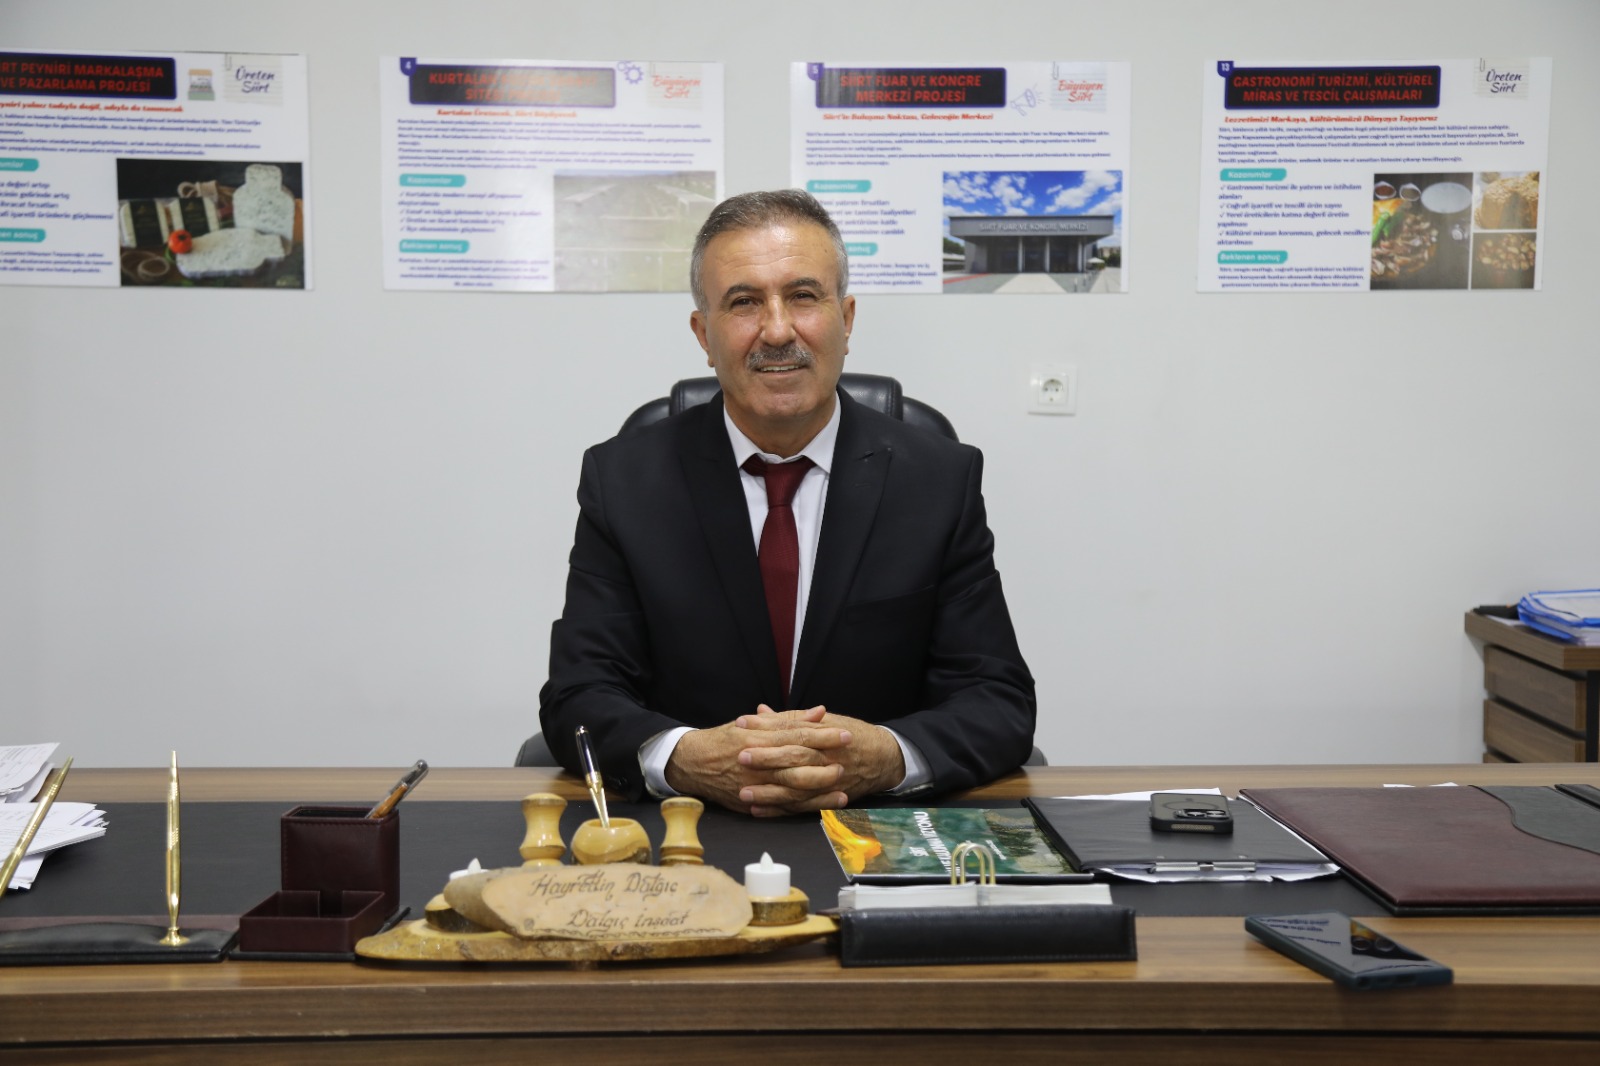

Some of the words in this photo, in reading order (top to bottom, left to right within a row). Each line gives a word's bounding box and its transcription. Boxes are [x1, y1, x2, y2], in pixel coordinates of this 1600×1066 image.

[21, 60, 71, 75] PEYNİRİ
[74, 63, 164, 78] MARKALAŞMA
[235, 66, 275, 81] Üreten
[1221, 63, 1230, 72] 13
[875, 74, 908, 87] FUAR
[911, 75, 926, 86] VE
[929, 74, 982, 87] KONGRE
[1233, 73, 1315, 88] GASTRONOMİ
[1318, 73, 1372, 88] TURİZMİ,
[1375, 73, 1434, 87] KÜLTÜREL
[1486, 68, 1522, 83] Üreten
[1, 77, 15, 88] VE
[19, 77, 96, 90] PAZARLAMA
[99, 79, 151, 93] PROJESİ
[241, 80, 270, 93] Siirt
[1490, 82, 1516, 94] Siirt
[855, 87, 911, 102] MERKEZİ
[914, 88, 966, 102] PROJESİ
[1243, 88, 1282, 102] MİRAS
[1285, 90, 1299, 101] VE
[1302, 88, 1340, 102] TESCİL
[1343, 89, 1423, 104] ÇALIŞMALARI
